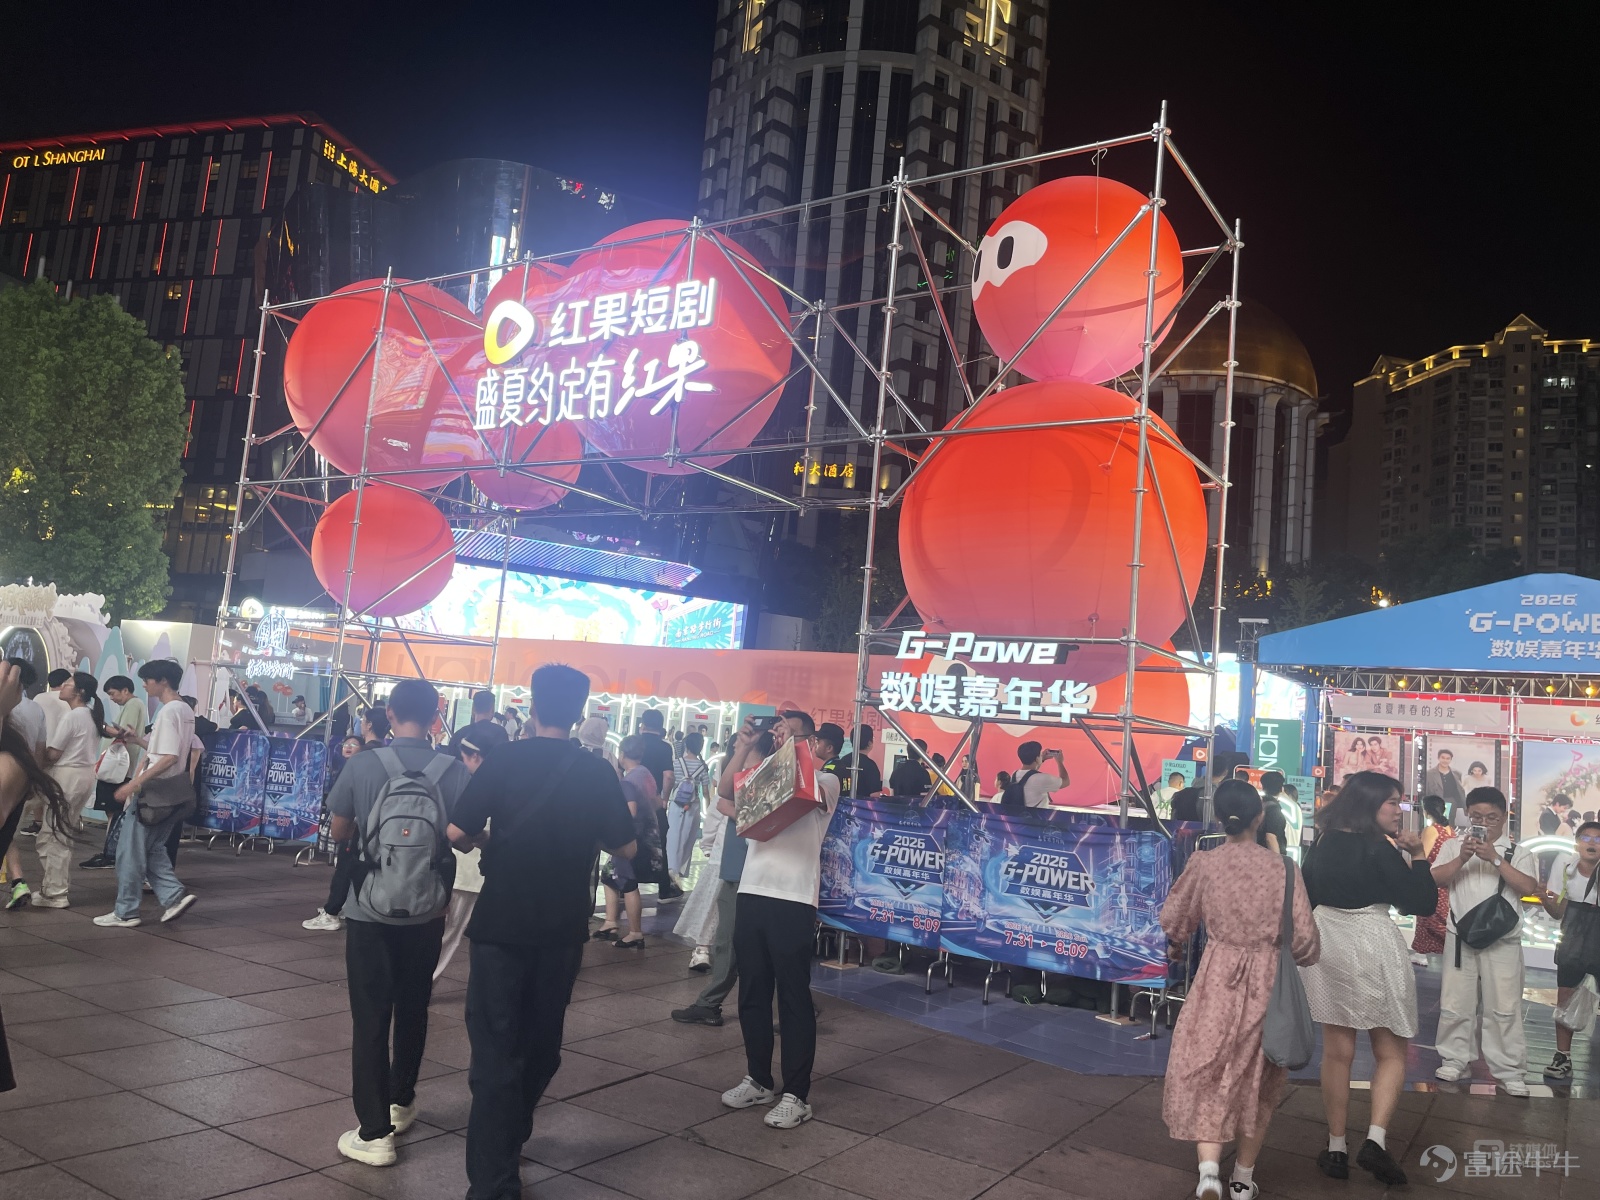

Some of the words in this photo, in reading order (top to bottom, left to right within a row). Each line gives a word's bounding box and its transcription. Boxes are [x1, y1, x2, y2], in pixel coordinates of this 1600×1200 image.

[42, 148, 105, 166] SHANGHAI
[549, 277, 717, 348] 红果短剧
[1520, 593, 1578, 607] 2026
[878, 671, 1090, 724] 数娱嘉年华
[1373, 702, 1456, 719] 盛夏青春的约定
[211, 755, 228, 764] 2026
[270, 761, 287, 771] 2026
[893, 834, 926, 849] 2026
[867, 843, 945, 870] G-POWER
[1030, 852, 1069, 869] 2026
[883, 866, 930, 880] 数娱嘉年华
[1001, 860, 1097, 895] G-POWER
[1019, 886, 1075, 902] 数娱嘉年华
[870, 907, 895, 923] 7.31
[913, 915, 941, 933] 8.09
[1004, 931, 1033, 948] 7.31
[1054, 940, 1088, 958] 8.09
